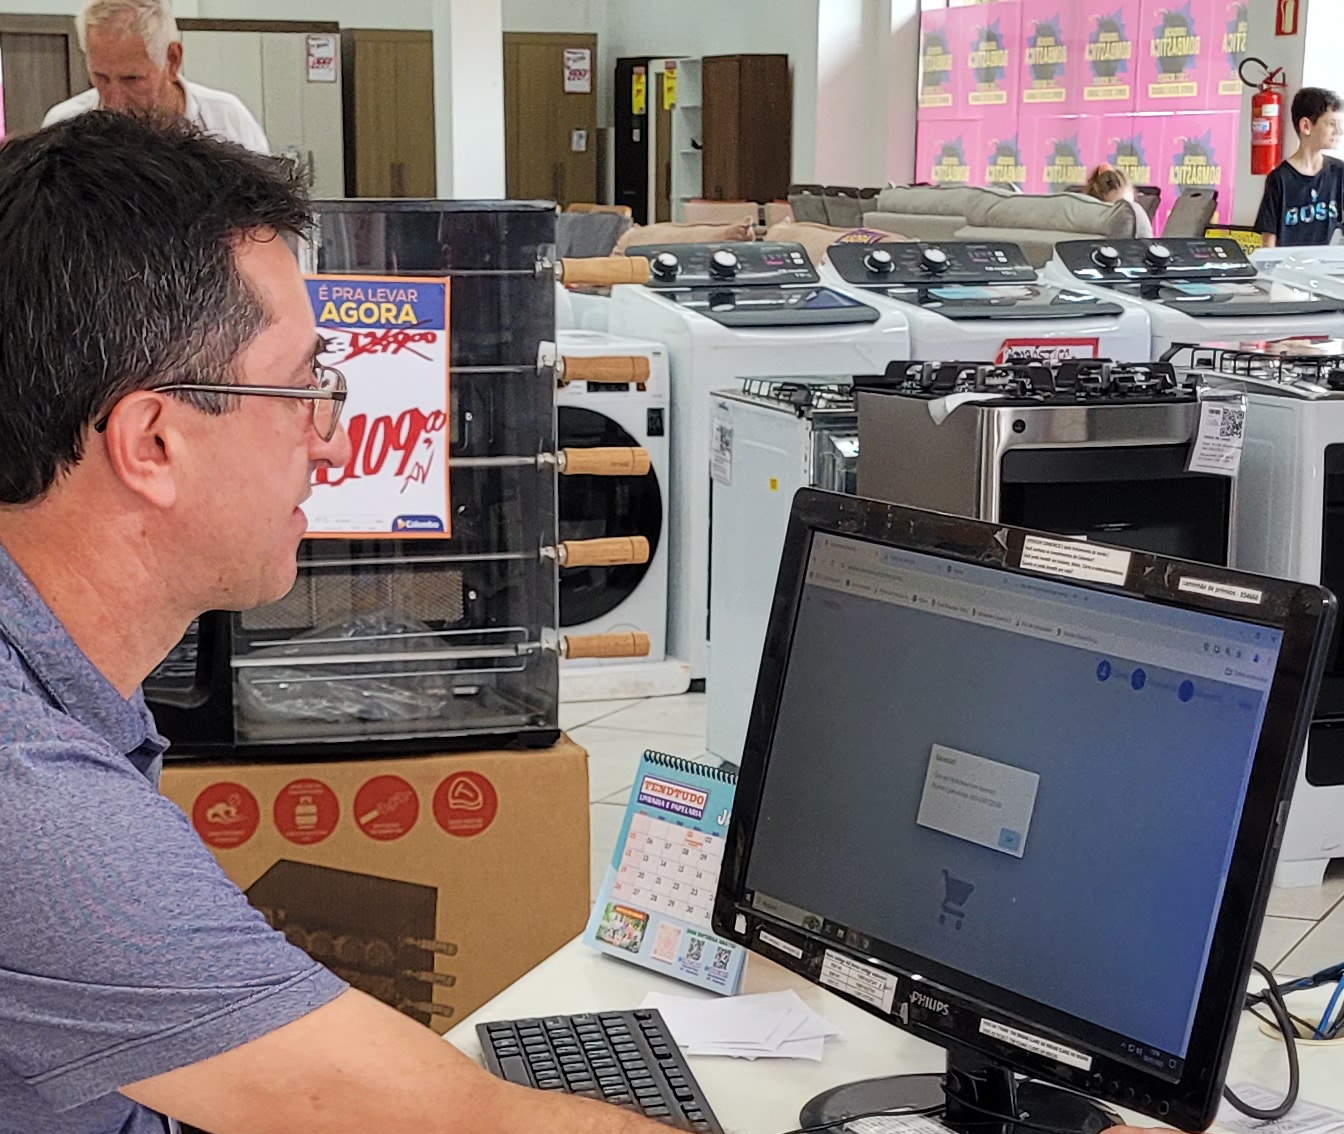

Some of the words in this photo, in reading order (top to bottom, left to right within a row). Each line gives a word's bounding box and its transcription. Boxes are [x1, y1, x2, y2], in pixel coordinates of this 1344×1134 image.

[1285, 200, 1338, 225] BOSS
[319, 284, 328, 300] É
[332, 287, 365, 301] PRA
[368, 288, 417, 302] LEVAR
[320, 302, 417, 324] AGORA
[644, 780, 705, 805] TENDTUDO
[671, 802, 702, 818] PAPELARIA
[912, 991, 949, 1016] PHILIPS
